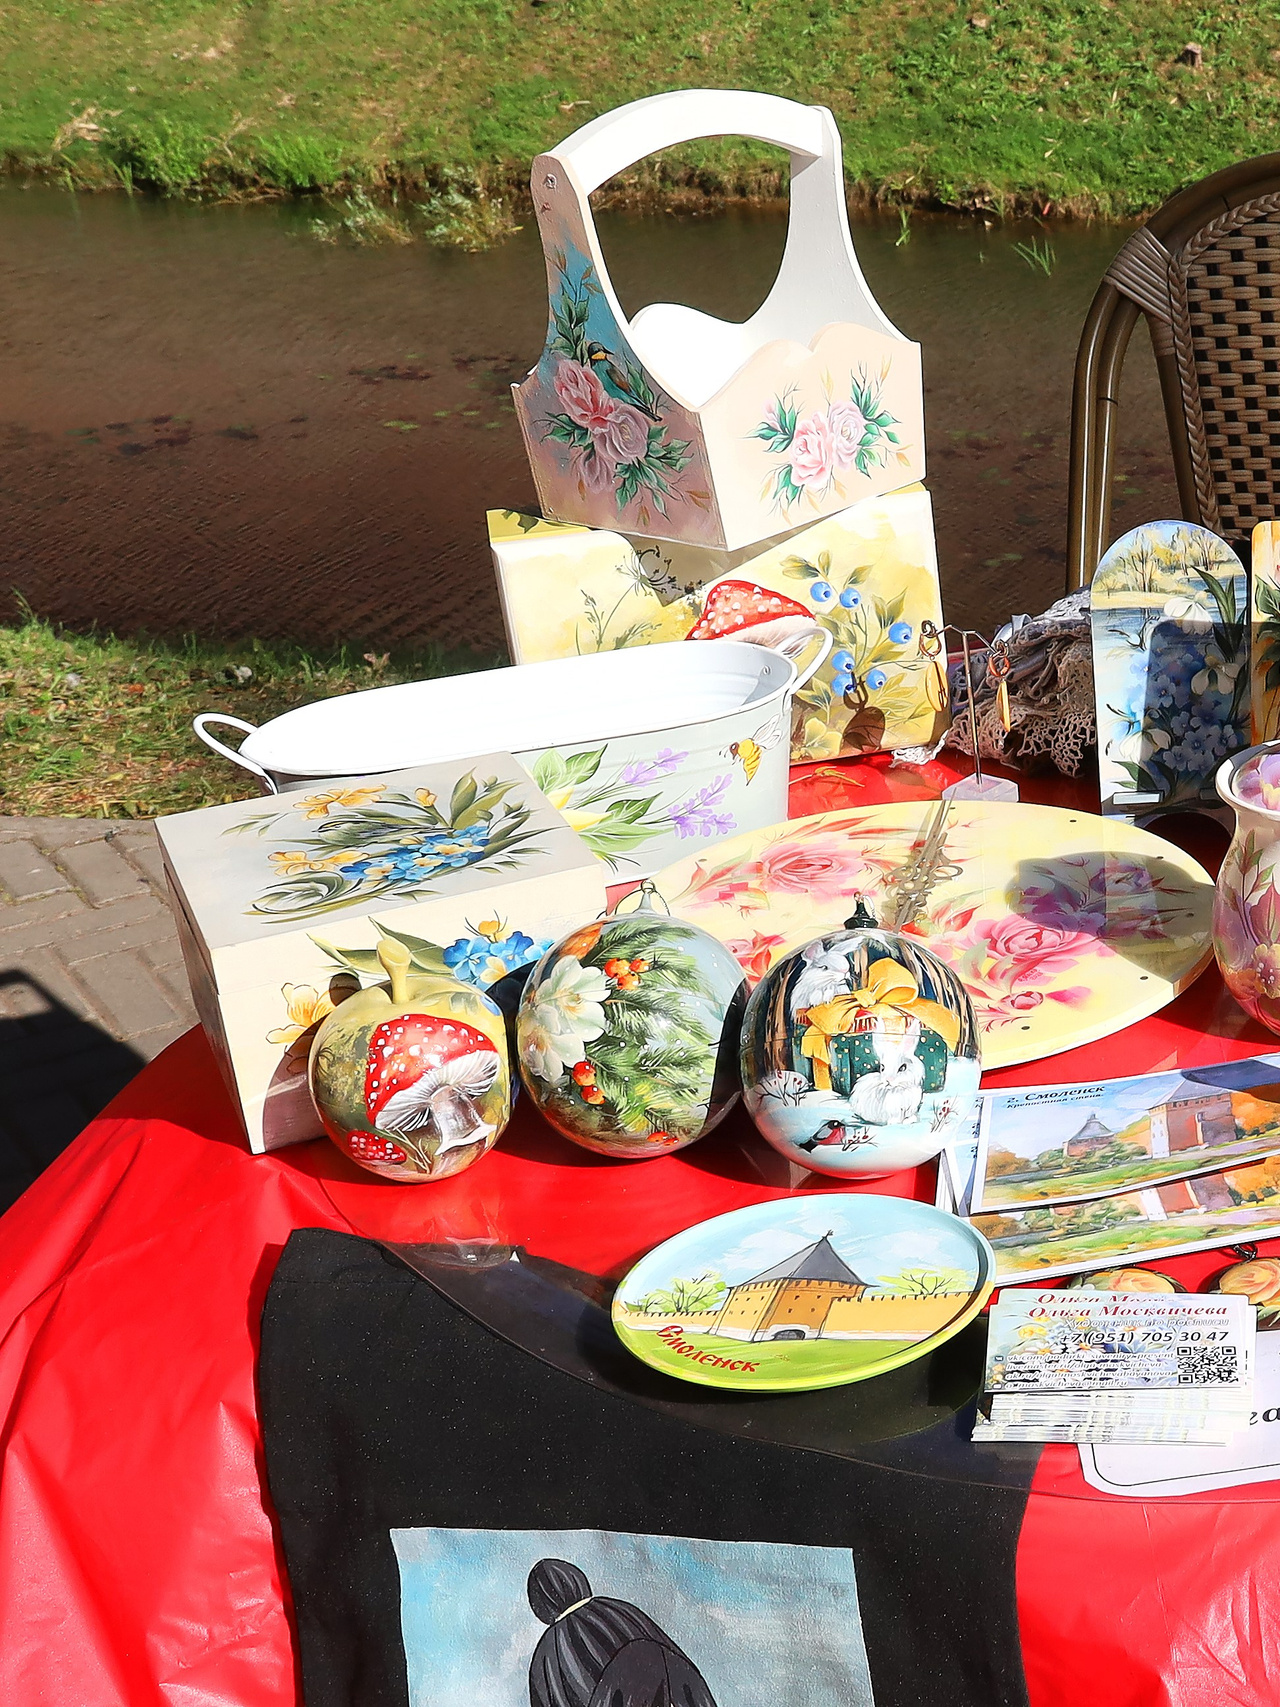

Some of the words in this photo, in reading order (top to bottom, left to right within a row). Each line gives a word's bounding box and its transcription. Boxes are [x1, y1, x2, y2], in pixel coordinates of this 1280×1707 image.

[1024, 1086, 1106, 1101] Смоленск
[1028, 1306, 1091, 1318] Ольга
[1099, 1305, 1228, 1317] Москвичева
[1060, 1332, 1082, 1343] +7
[1087, 1332, 1135, 1345] (951)
[1141, 1331, 1173, 1342] 705
[1178, 1331, 1202, 1342] 30
[1206, 1331, 1230, 1342] 47
